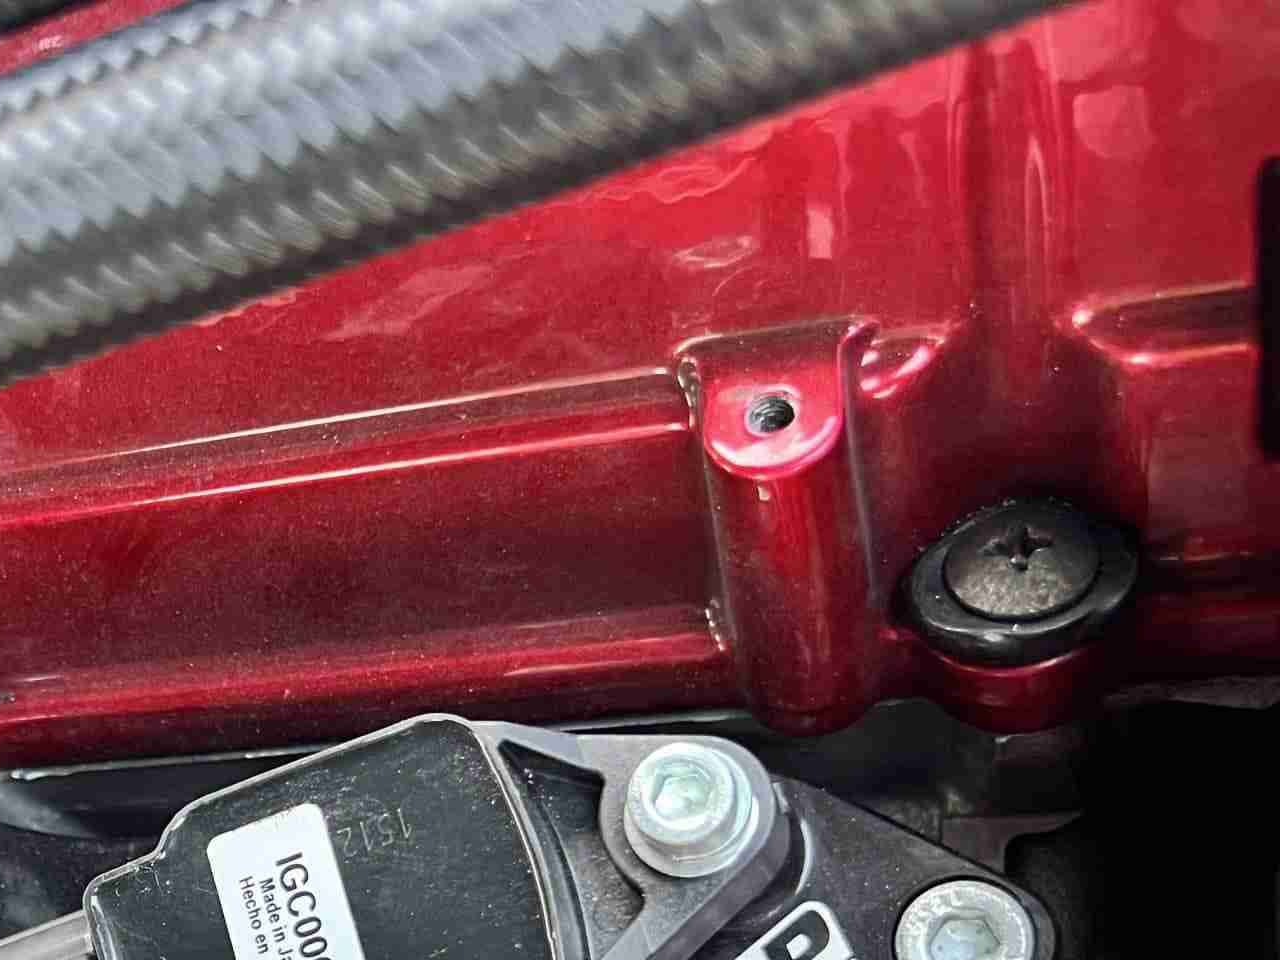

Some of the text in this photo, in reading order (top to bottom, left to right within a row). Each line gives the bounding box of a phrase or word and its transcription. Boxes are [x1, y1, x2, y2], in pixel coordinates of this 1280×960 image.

[335, 807, 413, 858] 1512
[238, 875, 262, 930] Hecho
[255, 933, 269, 954] en
[259, 877, 281, 924] Made
[272, 924, 288, 943] in
